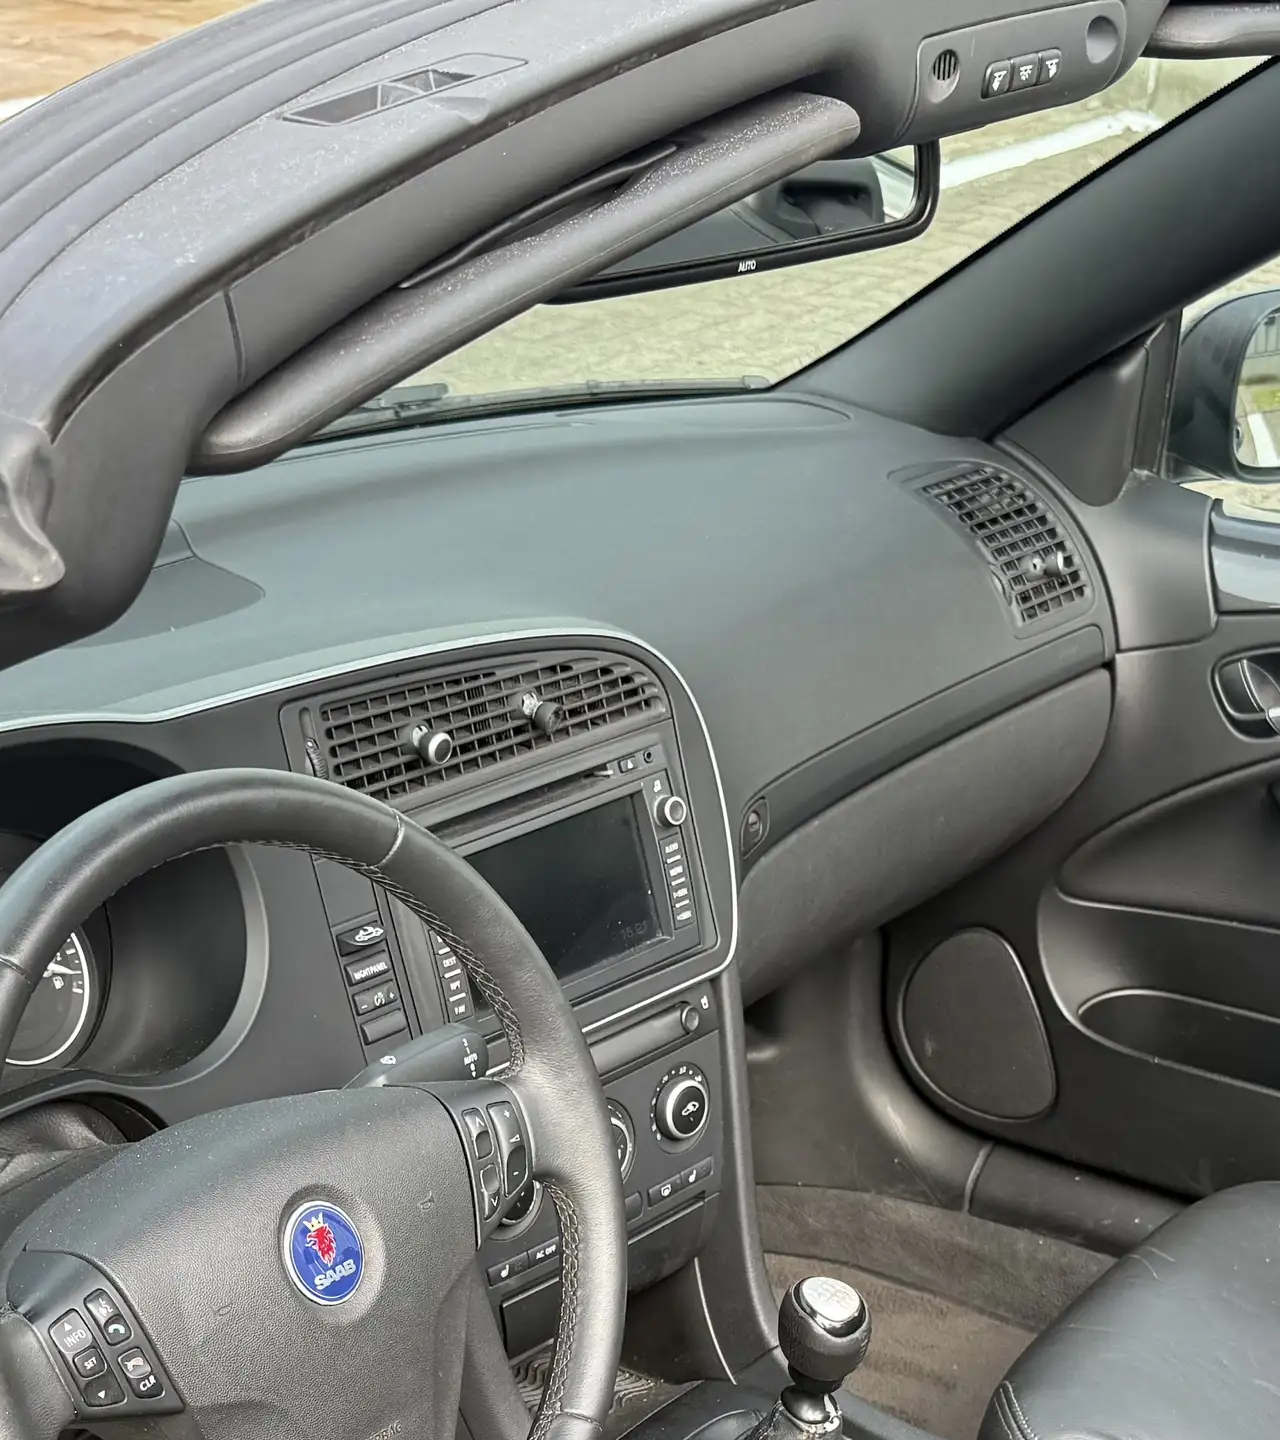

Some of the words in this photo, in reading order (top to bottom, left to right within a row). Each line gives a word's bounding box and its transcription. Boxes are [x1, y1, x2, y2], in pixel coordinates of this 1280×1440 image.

[737, 259, 757, 273] AUTO
[464, 1052, 478, 1066] AUTO
[535, 1249, 545, 1260] AC
[545, 1244, 557, 1256] OFF
[314, 1258, 357, 1290] SAAB
[63, 1328, 87, 1348] INFO
[83, 1356, 98, 1370] SET
[139, 1374, 157, 1392] CLR
